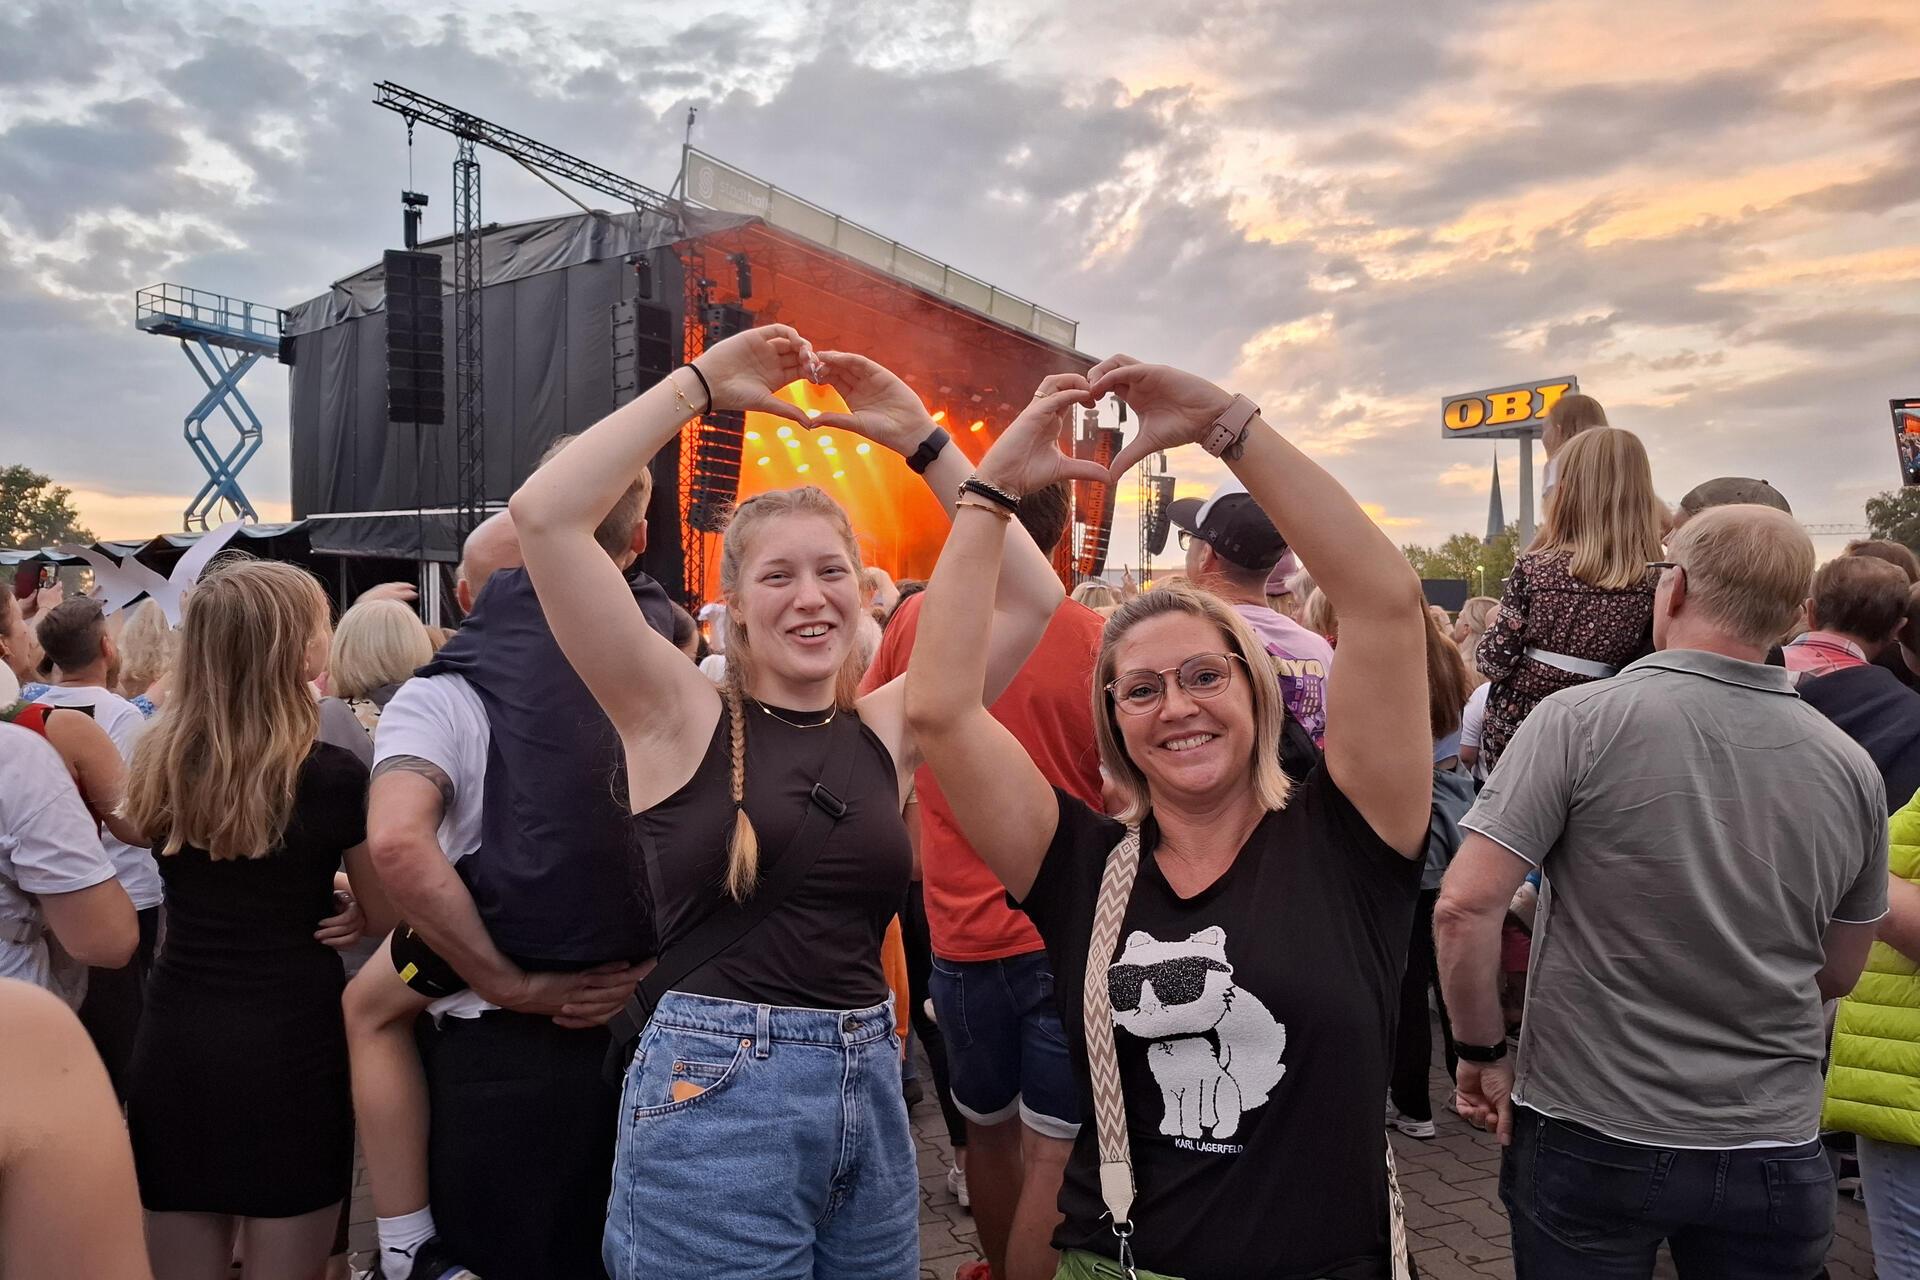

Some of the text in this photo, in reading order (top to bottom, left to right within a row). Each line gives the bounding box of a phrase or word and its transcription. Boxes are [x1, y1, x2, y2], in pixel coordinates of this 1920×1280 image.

[1444, 383, 1570, 430] OBI
[1174, 1137, 1244, 1154] KARL LAGERFELD
